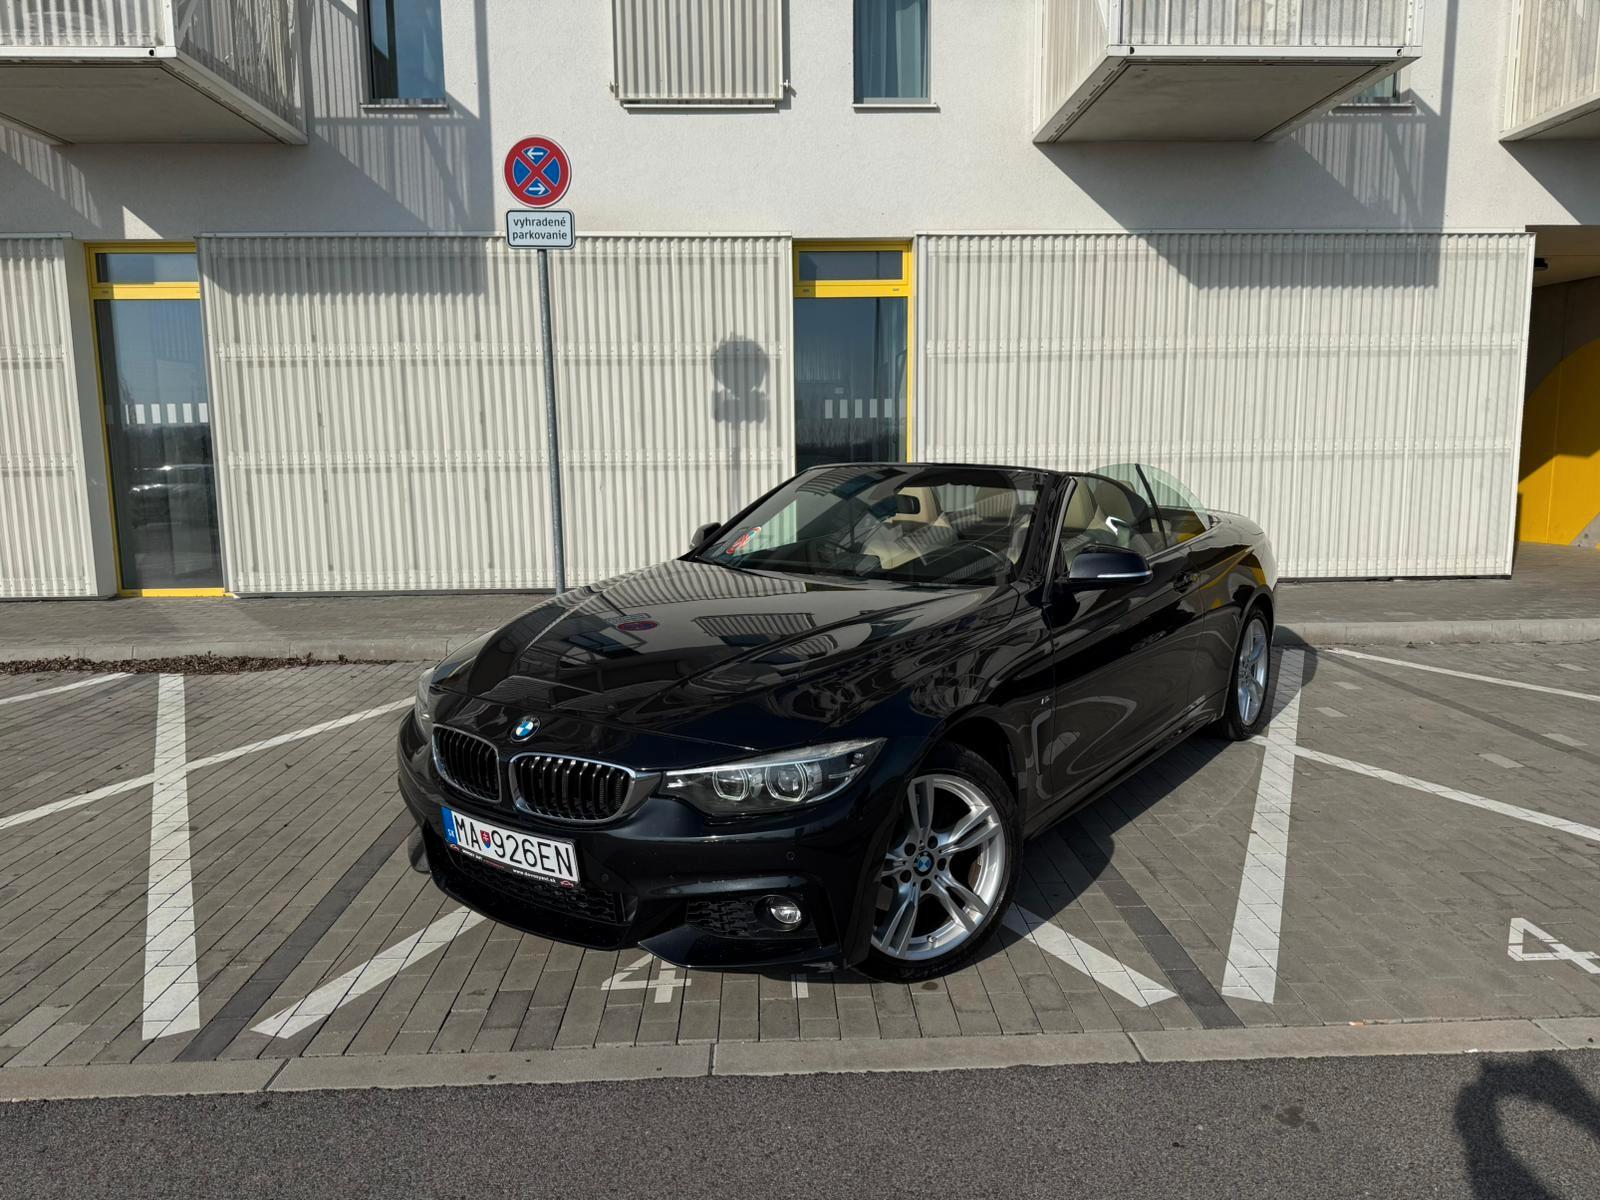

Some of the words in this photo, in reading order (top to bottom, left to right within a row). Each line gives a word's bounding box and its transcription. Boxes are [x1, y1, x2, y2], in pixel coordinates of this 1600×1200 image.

[513, 216, 566, 229] vyhradené
[512, 230, 568, 241] parkovanie
[454, 815, 482, 851] MA
[491, 830, 573, 877] 926EN
